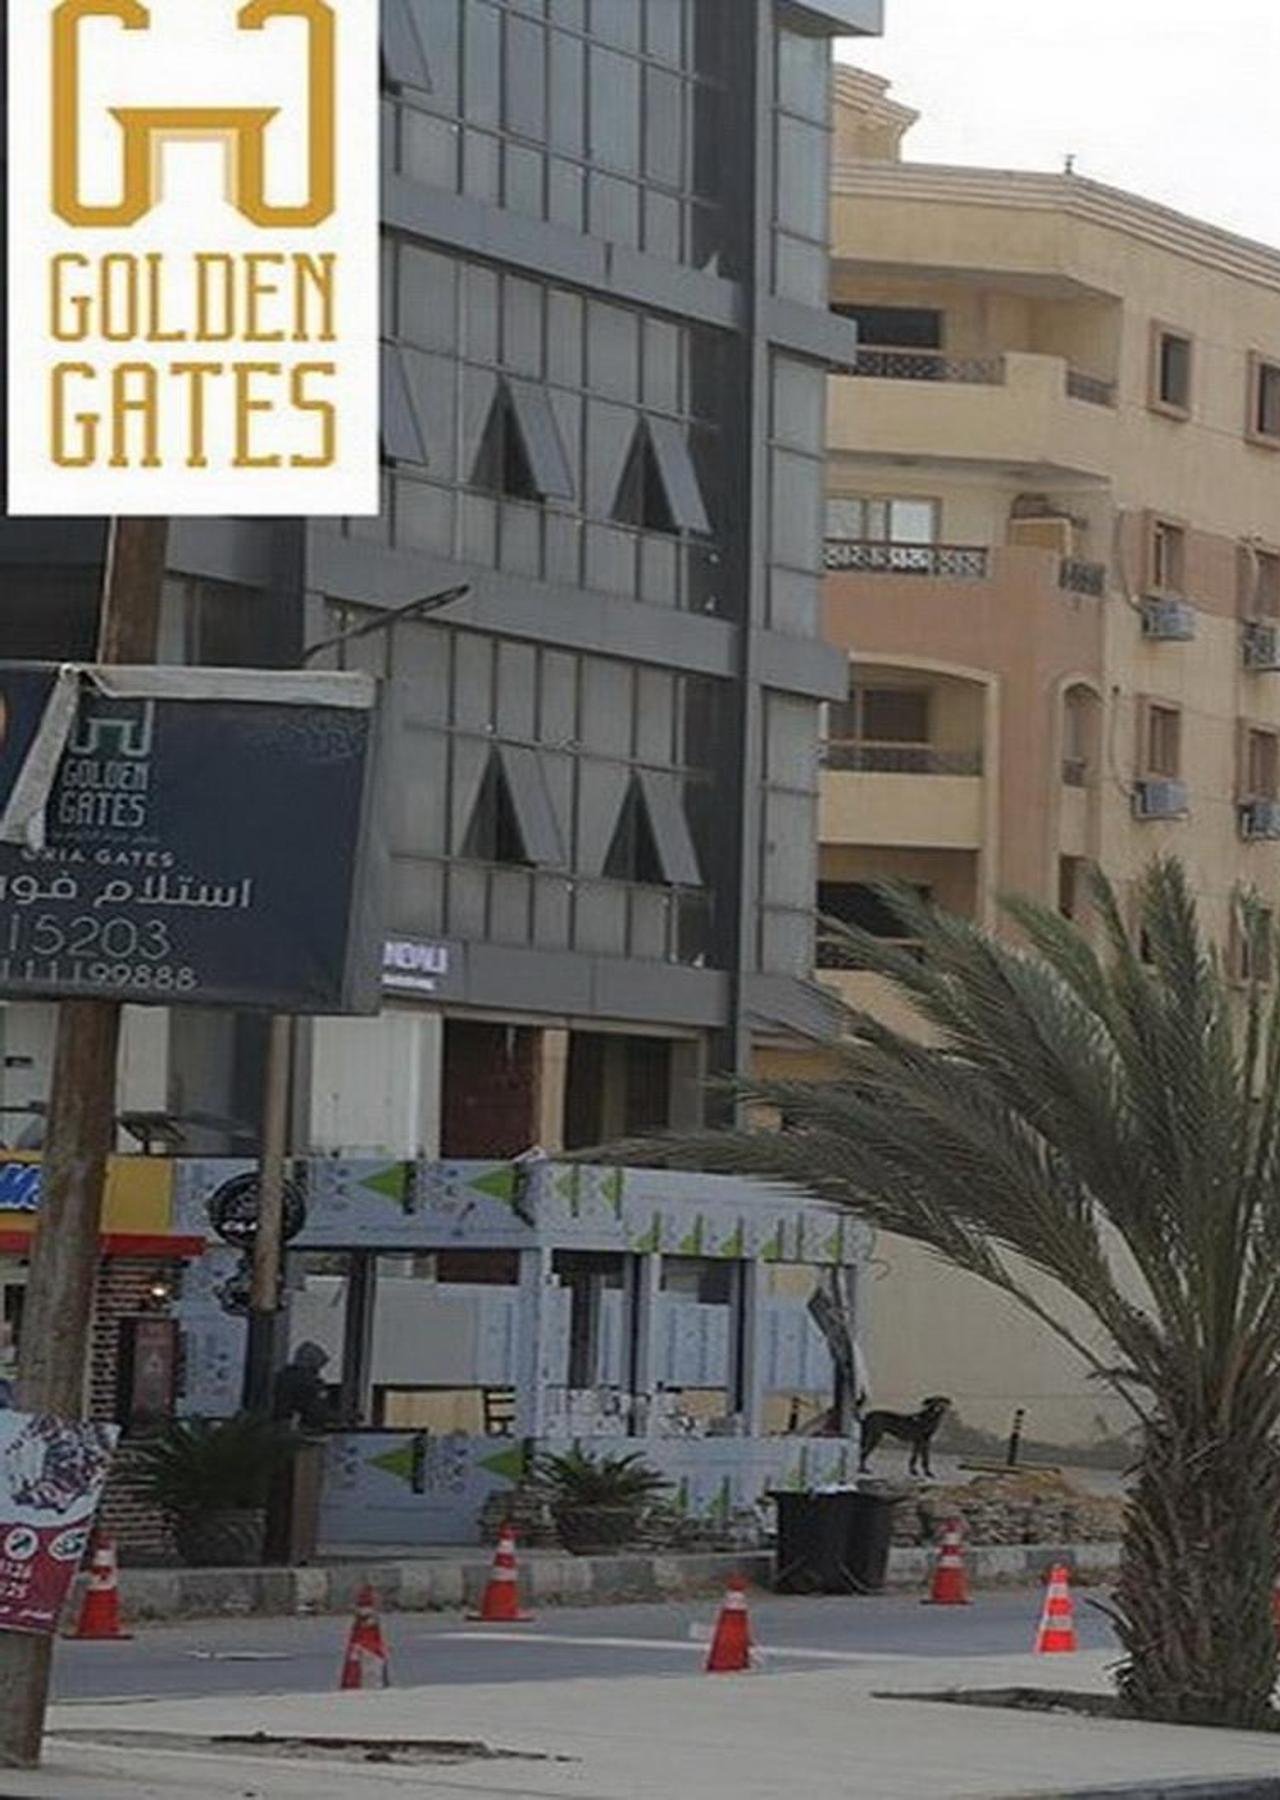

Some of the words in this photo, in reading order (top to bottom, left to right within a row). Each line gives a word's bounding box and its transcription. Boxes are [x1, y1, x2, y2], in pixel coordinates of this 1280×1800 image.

[59, 790, 146, 828] GATES
[95, 848, 175, 868] GATES
[93, 873, 252, 909] استلام
[9, 912, 172, 961] 15203
